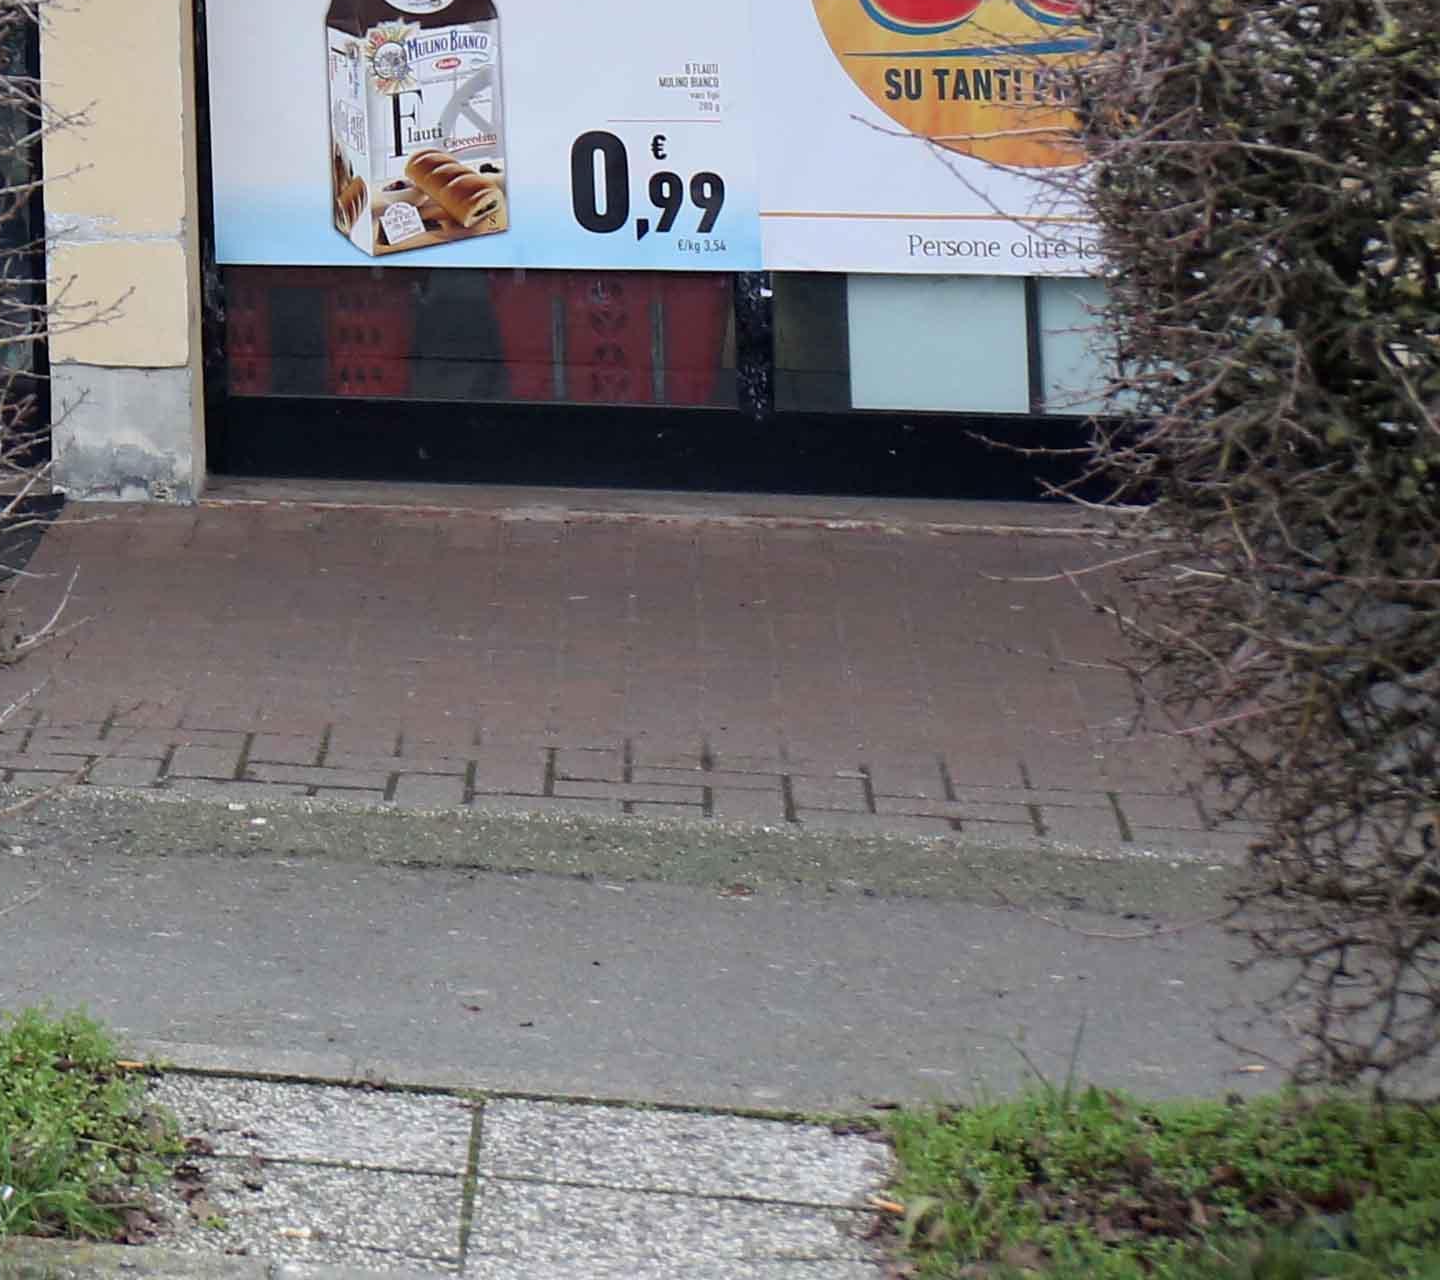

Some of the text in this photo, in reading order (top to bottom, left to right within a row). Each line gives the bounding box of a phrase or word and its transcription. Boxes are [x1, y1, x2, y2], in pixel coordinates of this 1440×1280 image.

[407, 31, 488, 61] MULINO BIANCO
[884, 68, 922, 101] SU
[650, 134, 668, 160] €
[570, 129, 726, 241] 0,99
[677, 237, 726, 254] €/kg 3,54
[907, 234, 1001, 257] Persone
